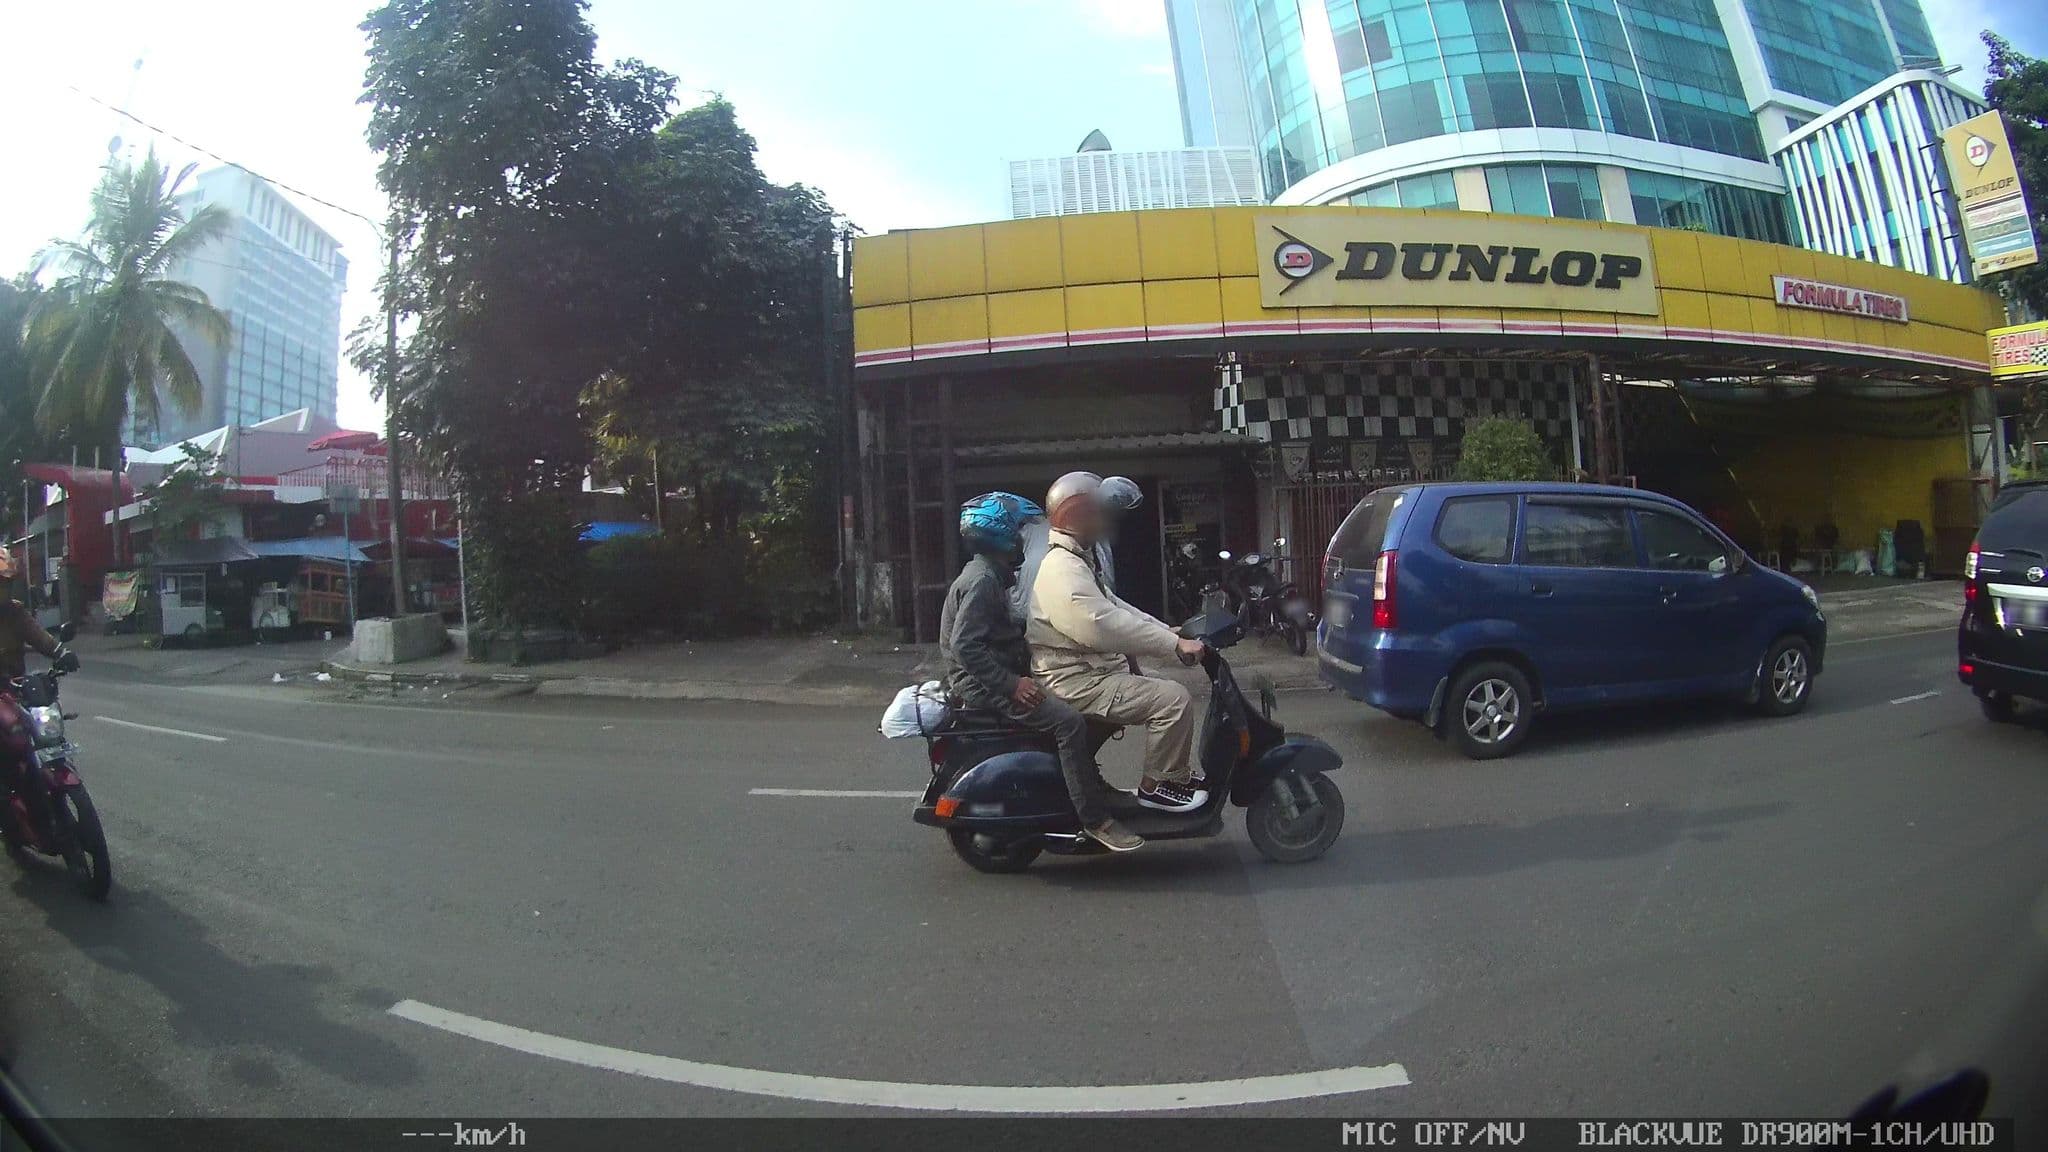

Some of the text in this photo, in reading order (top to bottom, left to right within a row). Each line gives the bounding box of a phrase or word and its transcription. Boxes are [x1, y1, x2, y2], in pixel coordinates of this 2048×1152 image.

[1965, 176, 2015, 199] DUNLOP
[1335, 241, 1642, 289] DUNLOP
[1783, 281, 1903, 319] FORMULA TIRES
[1992, 349, 2029, 366] TIRES
